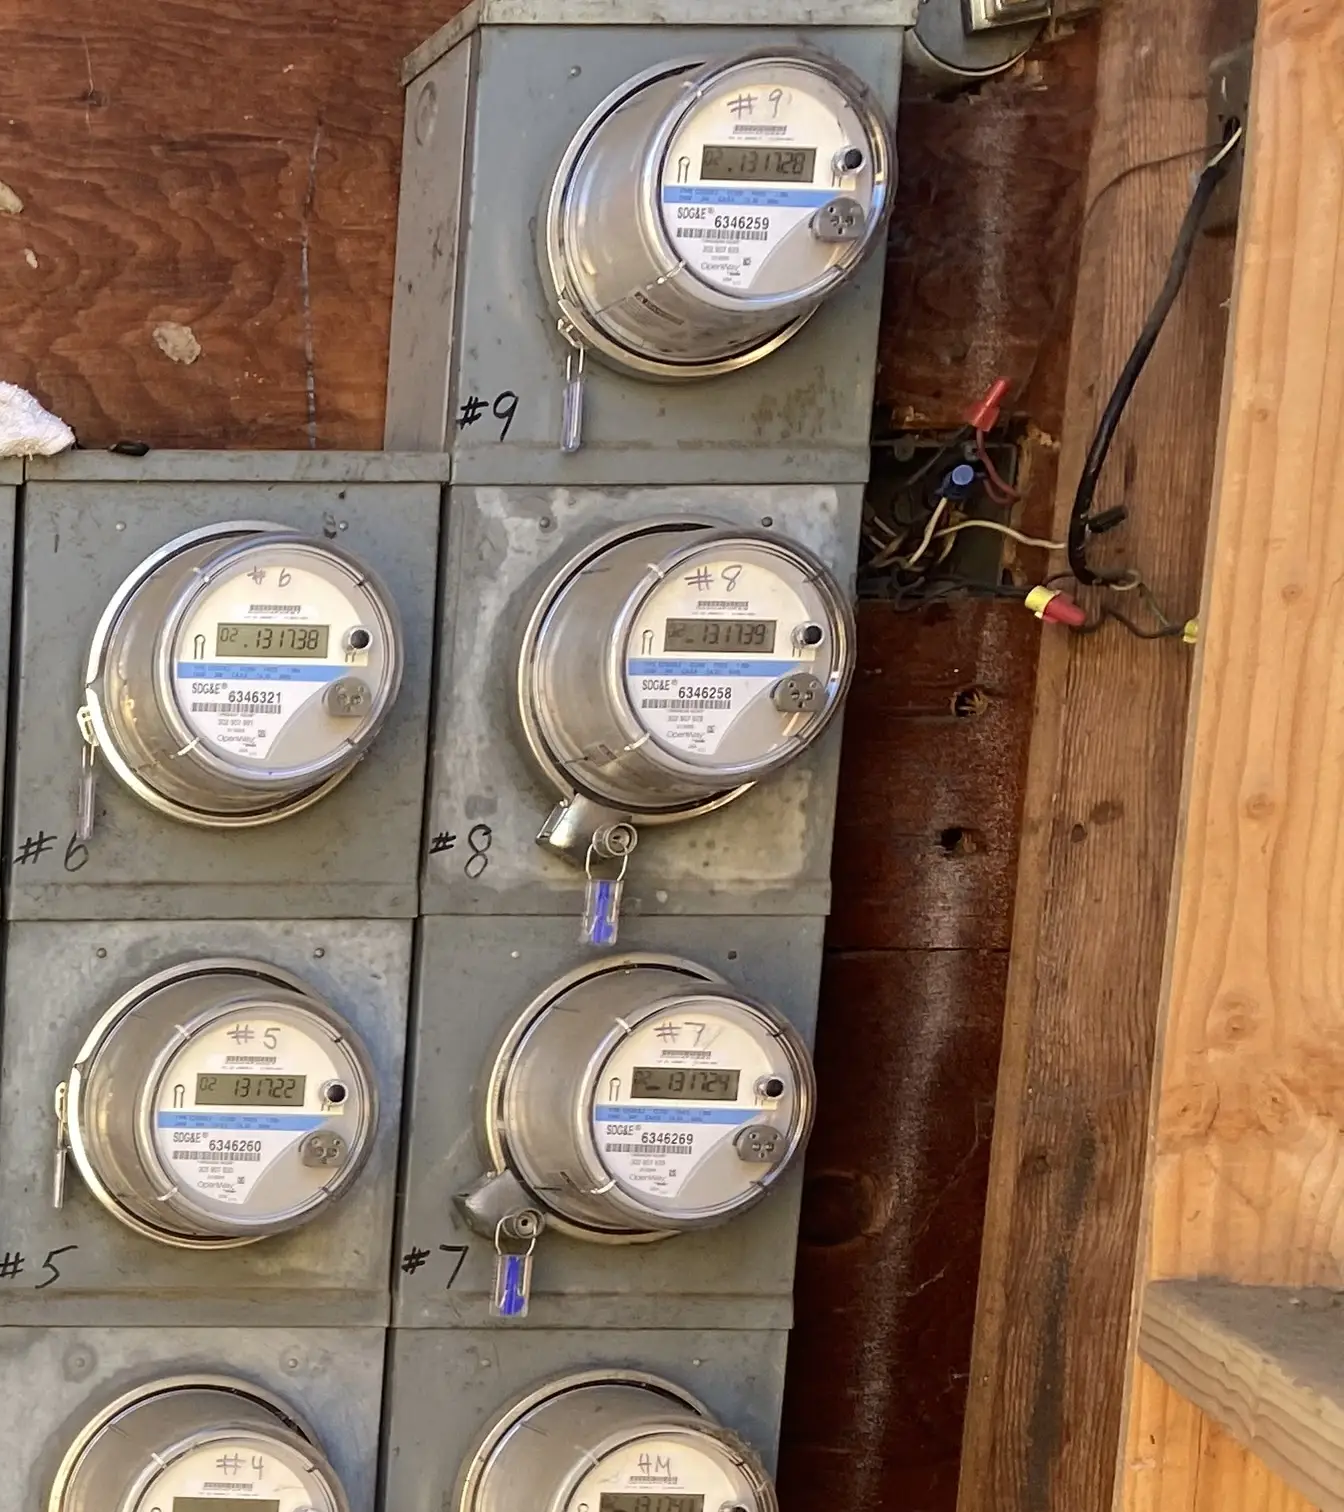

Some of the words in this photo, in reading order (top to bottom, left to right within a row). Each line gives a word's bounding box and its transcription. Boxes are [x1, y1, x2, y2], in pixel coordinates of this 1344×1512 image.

[714, 215, 770, 230] 6346259
[456, 391, 519, 442] #9
[228, 690, 282, 703] 6346321
[678, 687, 732, 699] 6346258
[12, 830, 91, 873] #6
[429, 823, 493, 879] #8
[209, 1140, 262, 1152] 6346260
[641, 1132, 694, 1145] 6346269
[401, 1244, 470, 1290] #7
